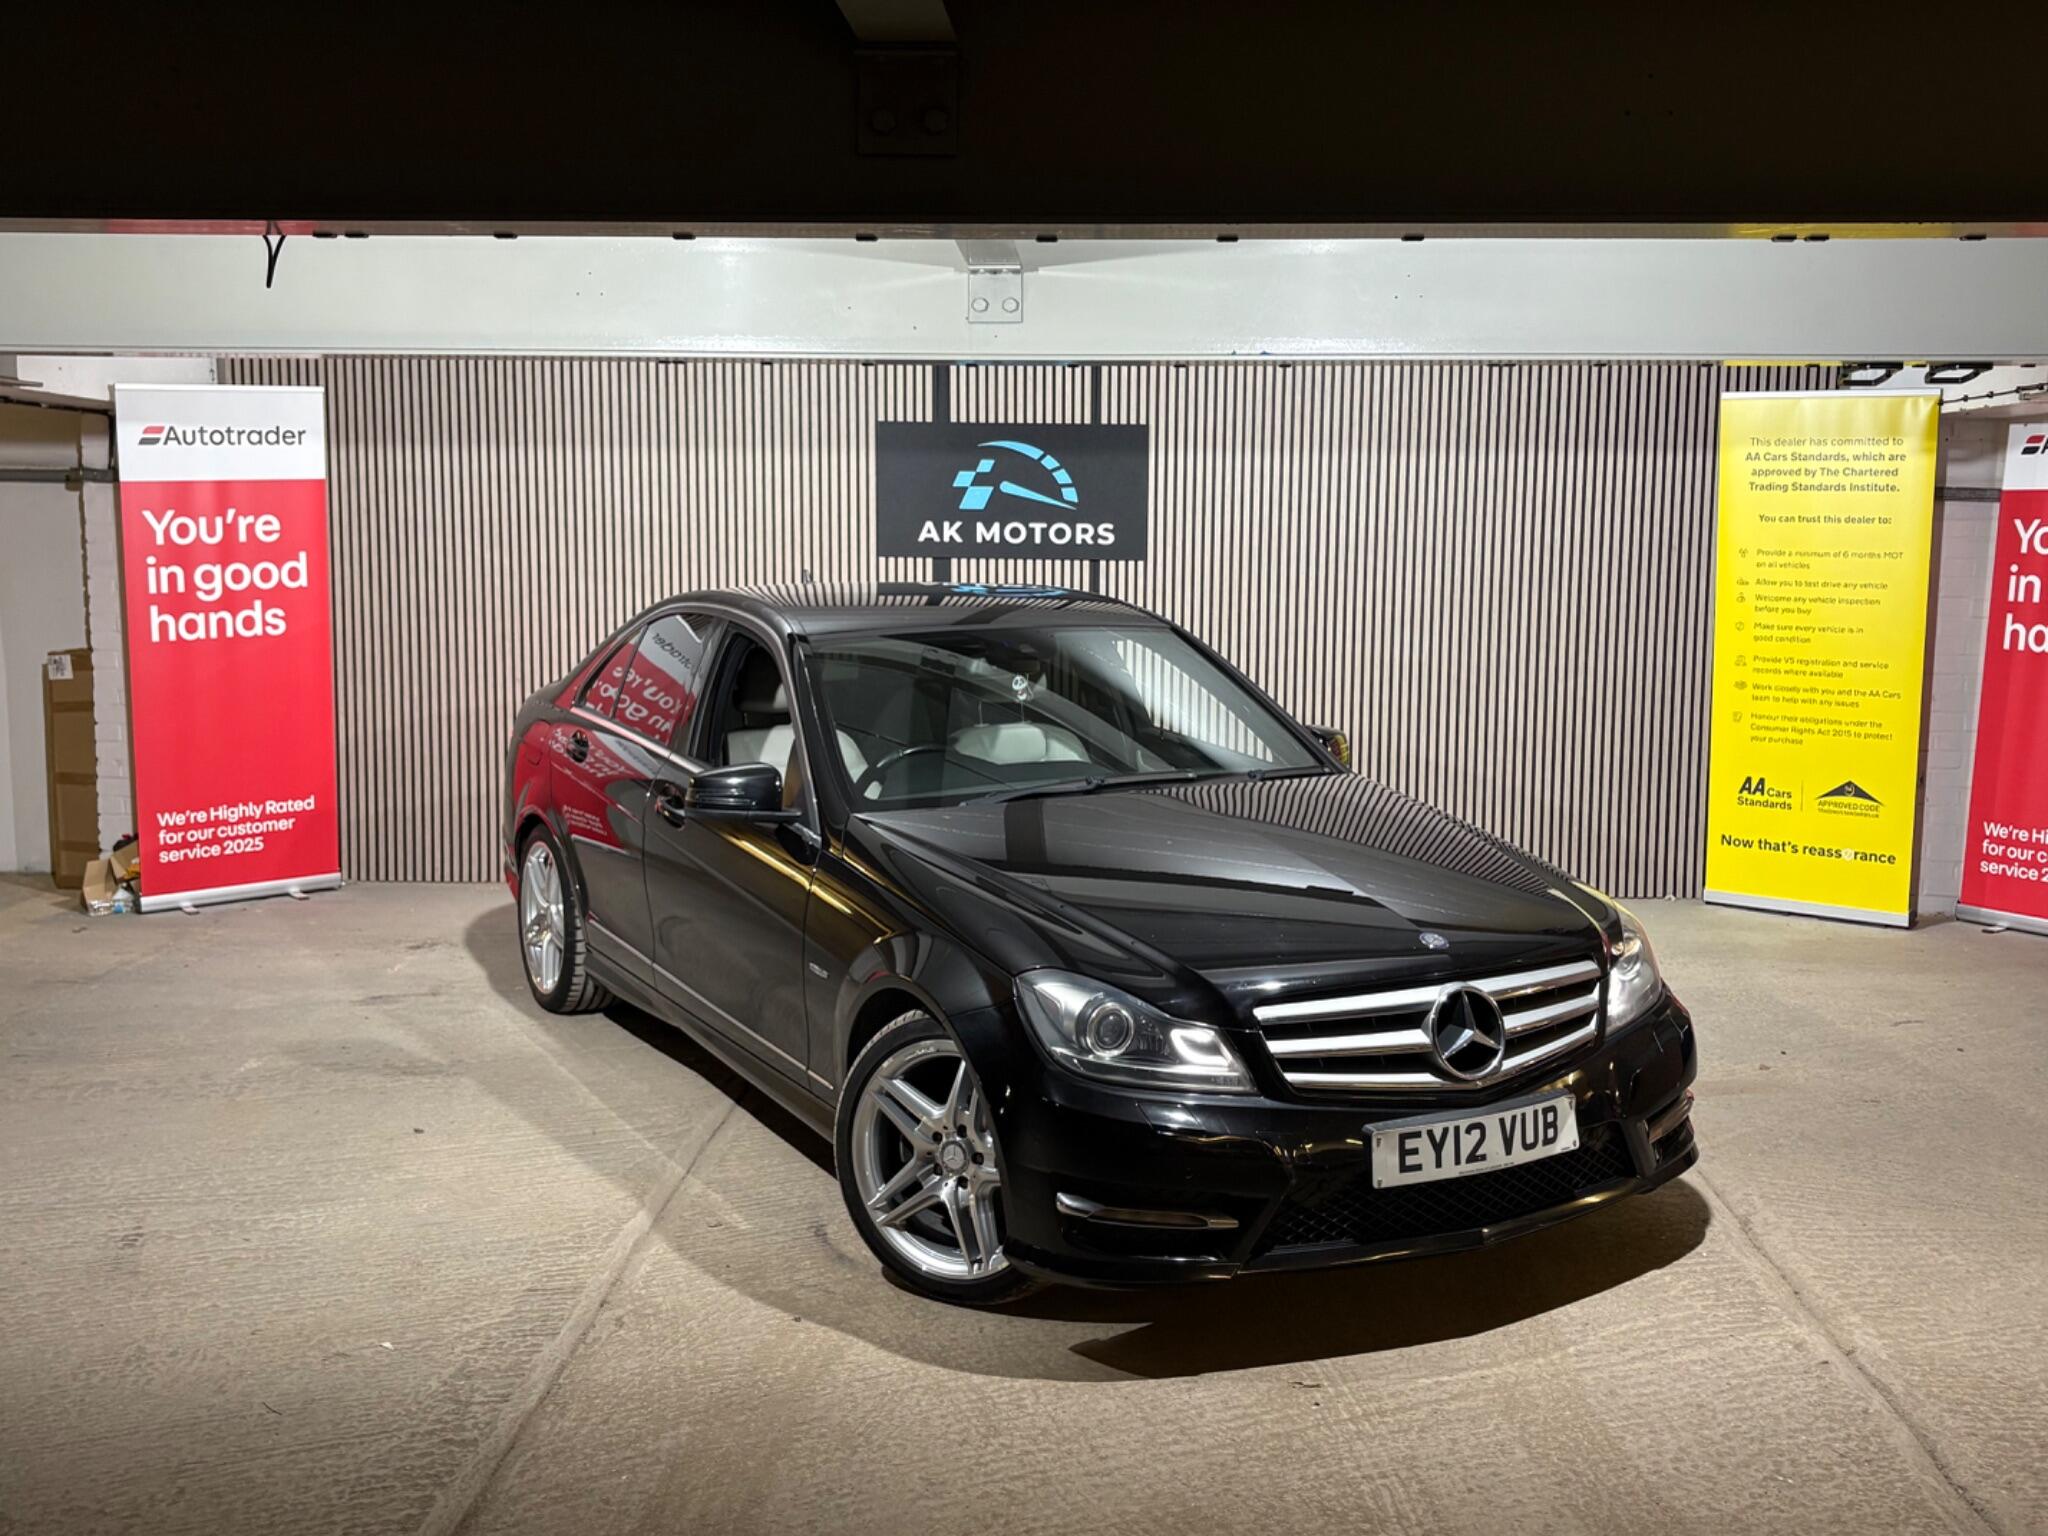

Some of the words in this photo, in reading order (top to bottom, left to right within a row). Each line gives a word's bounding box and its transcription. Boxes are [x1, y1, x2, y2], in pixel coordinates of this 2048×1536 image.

[163, 426, 306, 446] Autotrader
[1750, 437, 1771, 447] This
[1774, 437, 1805, 447] dealer
[1810, 437, 1828, 447] has
[1831, 437, 1890, 447] committed
[1892, 437, 1904, 447] to
[1745, 452, 1761, 461] AA
[1763, 452, 1787, 461] Cars
[1791, 451, 1849, 463] Standards,
[1853, 452, 1885, 461] which
[1888, 453, 1907, 462] are
[1751, 467, 1801, 478] approved
[1804, 467, 1817, 478] by
[1820, 467, 1839, 476] The
[1842, 467, 1899, 477] Chartered
[1749, 481, 1789, 493] Trading
[1791, 481, 1846, 492] Standards
[1850, 482, 1900, 492] Institute.
[142, 508, 281, 546] You're
[1759, 514, 1776, 523] You
[1778, 515, 1795, 523] can
[1798, 514, 1821, 523] trust
[1824, 514, 1842, 524] this
[1844, 515, 1876, 524] dealer
[1878, 516, 1892, 525] to:
[918, 520, 964, 543] AK
[976, 521, 1116, 546] MOTORS
[146, 555, 186, 594] in
[193, 551, 308, 602] good
[2007, 564, 2042, 603] in
[150, 600, 287, 642] hands
[1738, 776, 1765, 796] AA
[1767, 787, 1792, 799] Cars
[156, 810, 208, 827] We're
[210, 803, 263, 823] Highly
[265, 796, 315, 814] Rated
[1737, 795, 1792, 810] Standards
[1818, 799, 1859, 810] APPROVED
[1859, 803, 1880, 812] CODE
[159, 829, 184, 846] for
[187, 827, 215, 842] our
[217, 816, 296, 839] customer
[1983, 821, 2029, 842] We're
[159, 844, 221, 864] service
[223, 837, 264, 856] 2025
[1720, 834, 1754, 848] Now
[1757, 837, 1799, 854] that's
[1982, 839, 2006, 856] for
[2007, 846, 2035, 861] our
[1980, 860, 2039, 880] service
[1398, 1122, 1487, 1174] EY12
[1499, 1105, 1559, 1157] VUB
